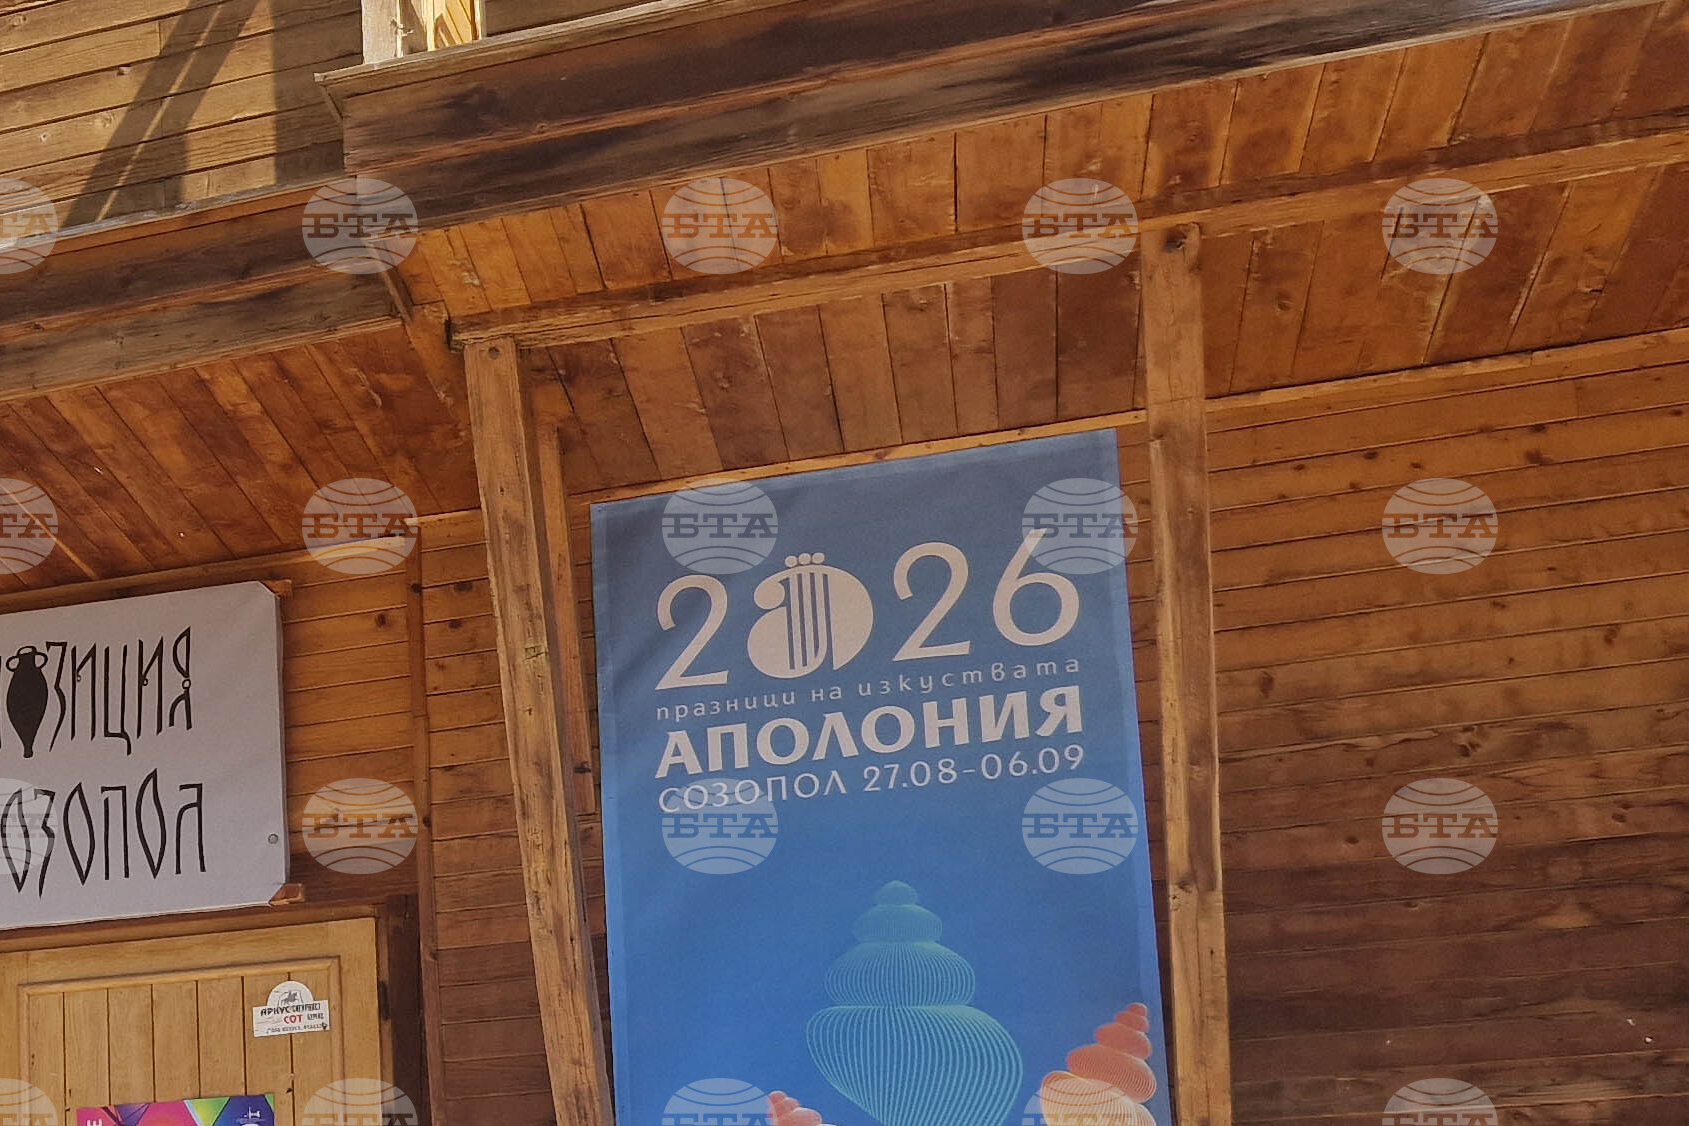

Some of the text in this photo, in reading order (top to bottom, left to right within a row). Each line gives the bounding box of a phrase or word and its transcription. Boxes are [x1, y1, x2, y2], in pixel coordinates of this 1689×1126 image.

[656, 658, 1080, 722] празници на изкуствата
[655, 685, 1083, 779] АПОЛОНИЯ
[658, 769, 848, 814] СОЗОПОЛ
